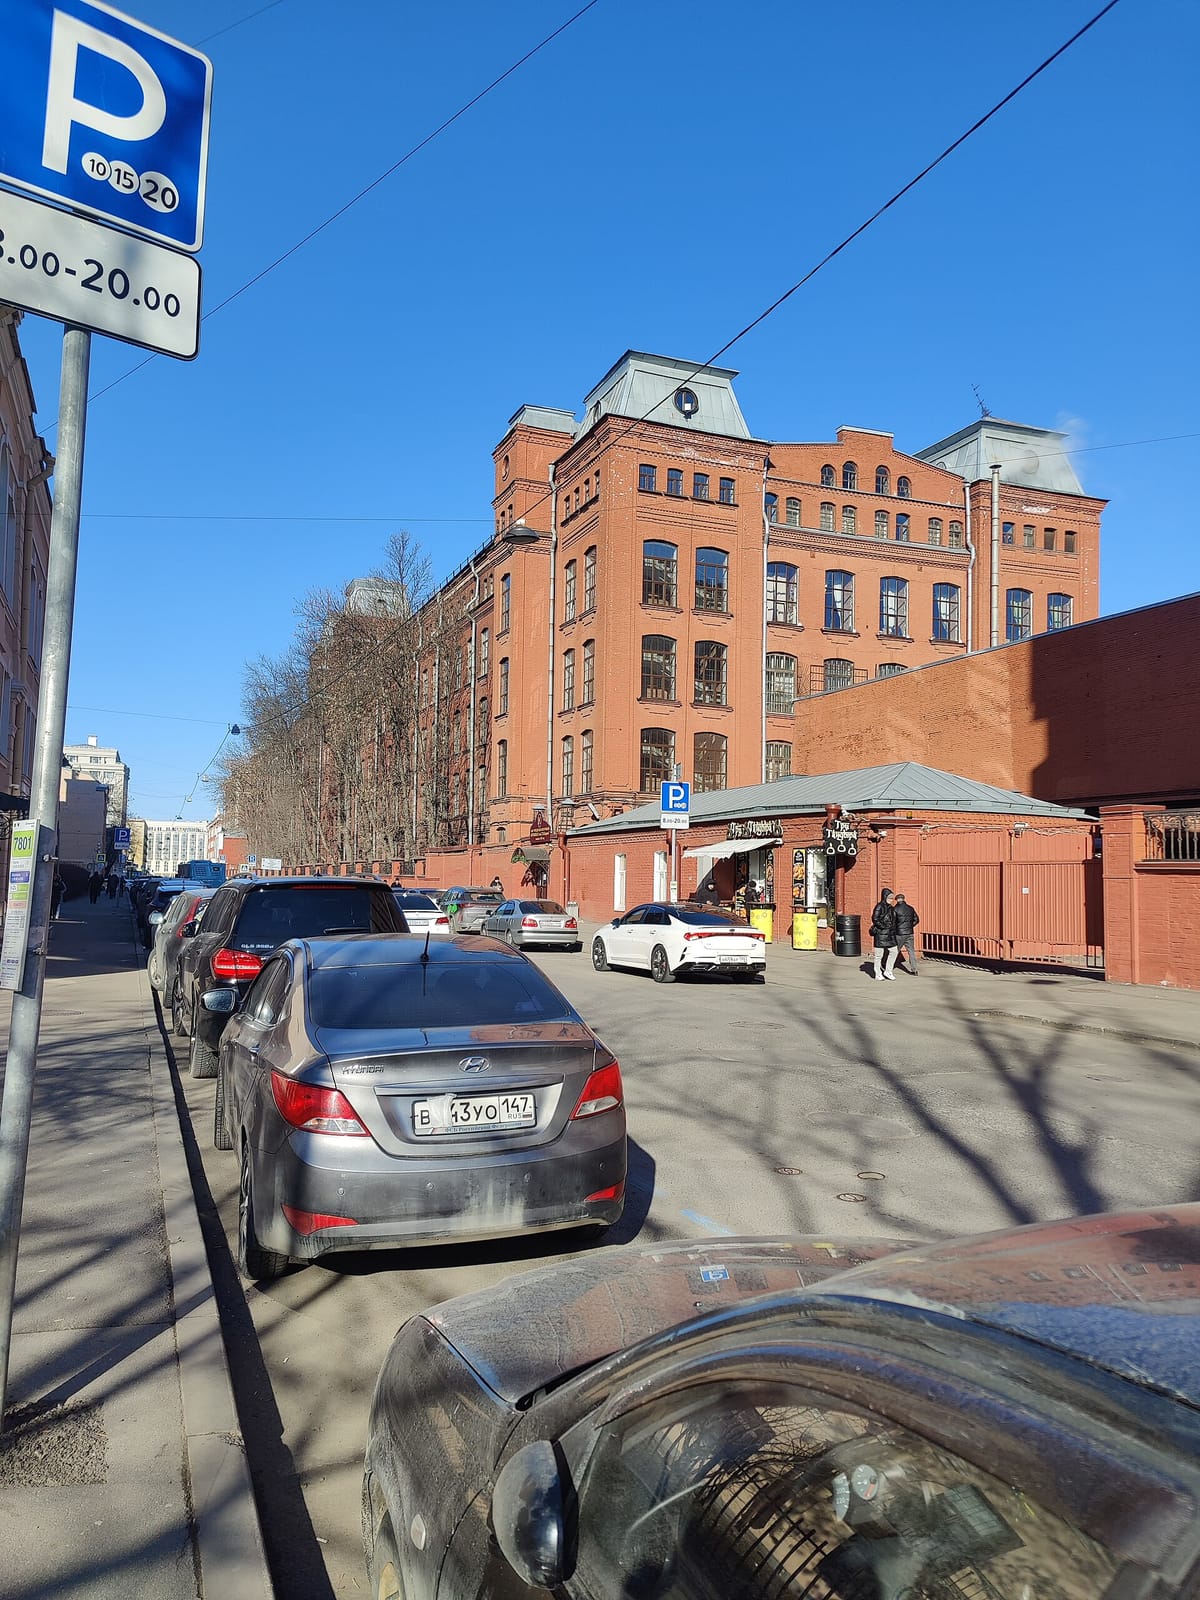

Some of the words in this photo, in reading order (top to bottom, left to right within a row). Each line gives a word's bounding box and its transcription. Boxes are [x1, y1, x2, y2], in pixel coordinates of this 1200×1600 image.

[42, 8, 167, 176] P
[89, 158, 107, 177] 10
[113, 167, 135, 191] 15
[143, 178, 177, 209] 20
[669, 785, 685, 808] P
[14, 835, 32, 851] 7801
[501, 1096, 529, 1113] 147
[507, 1112, 522, 1120] RUS
